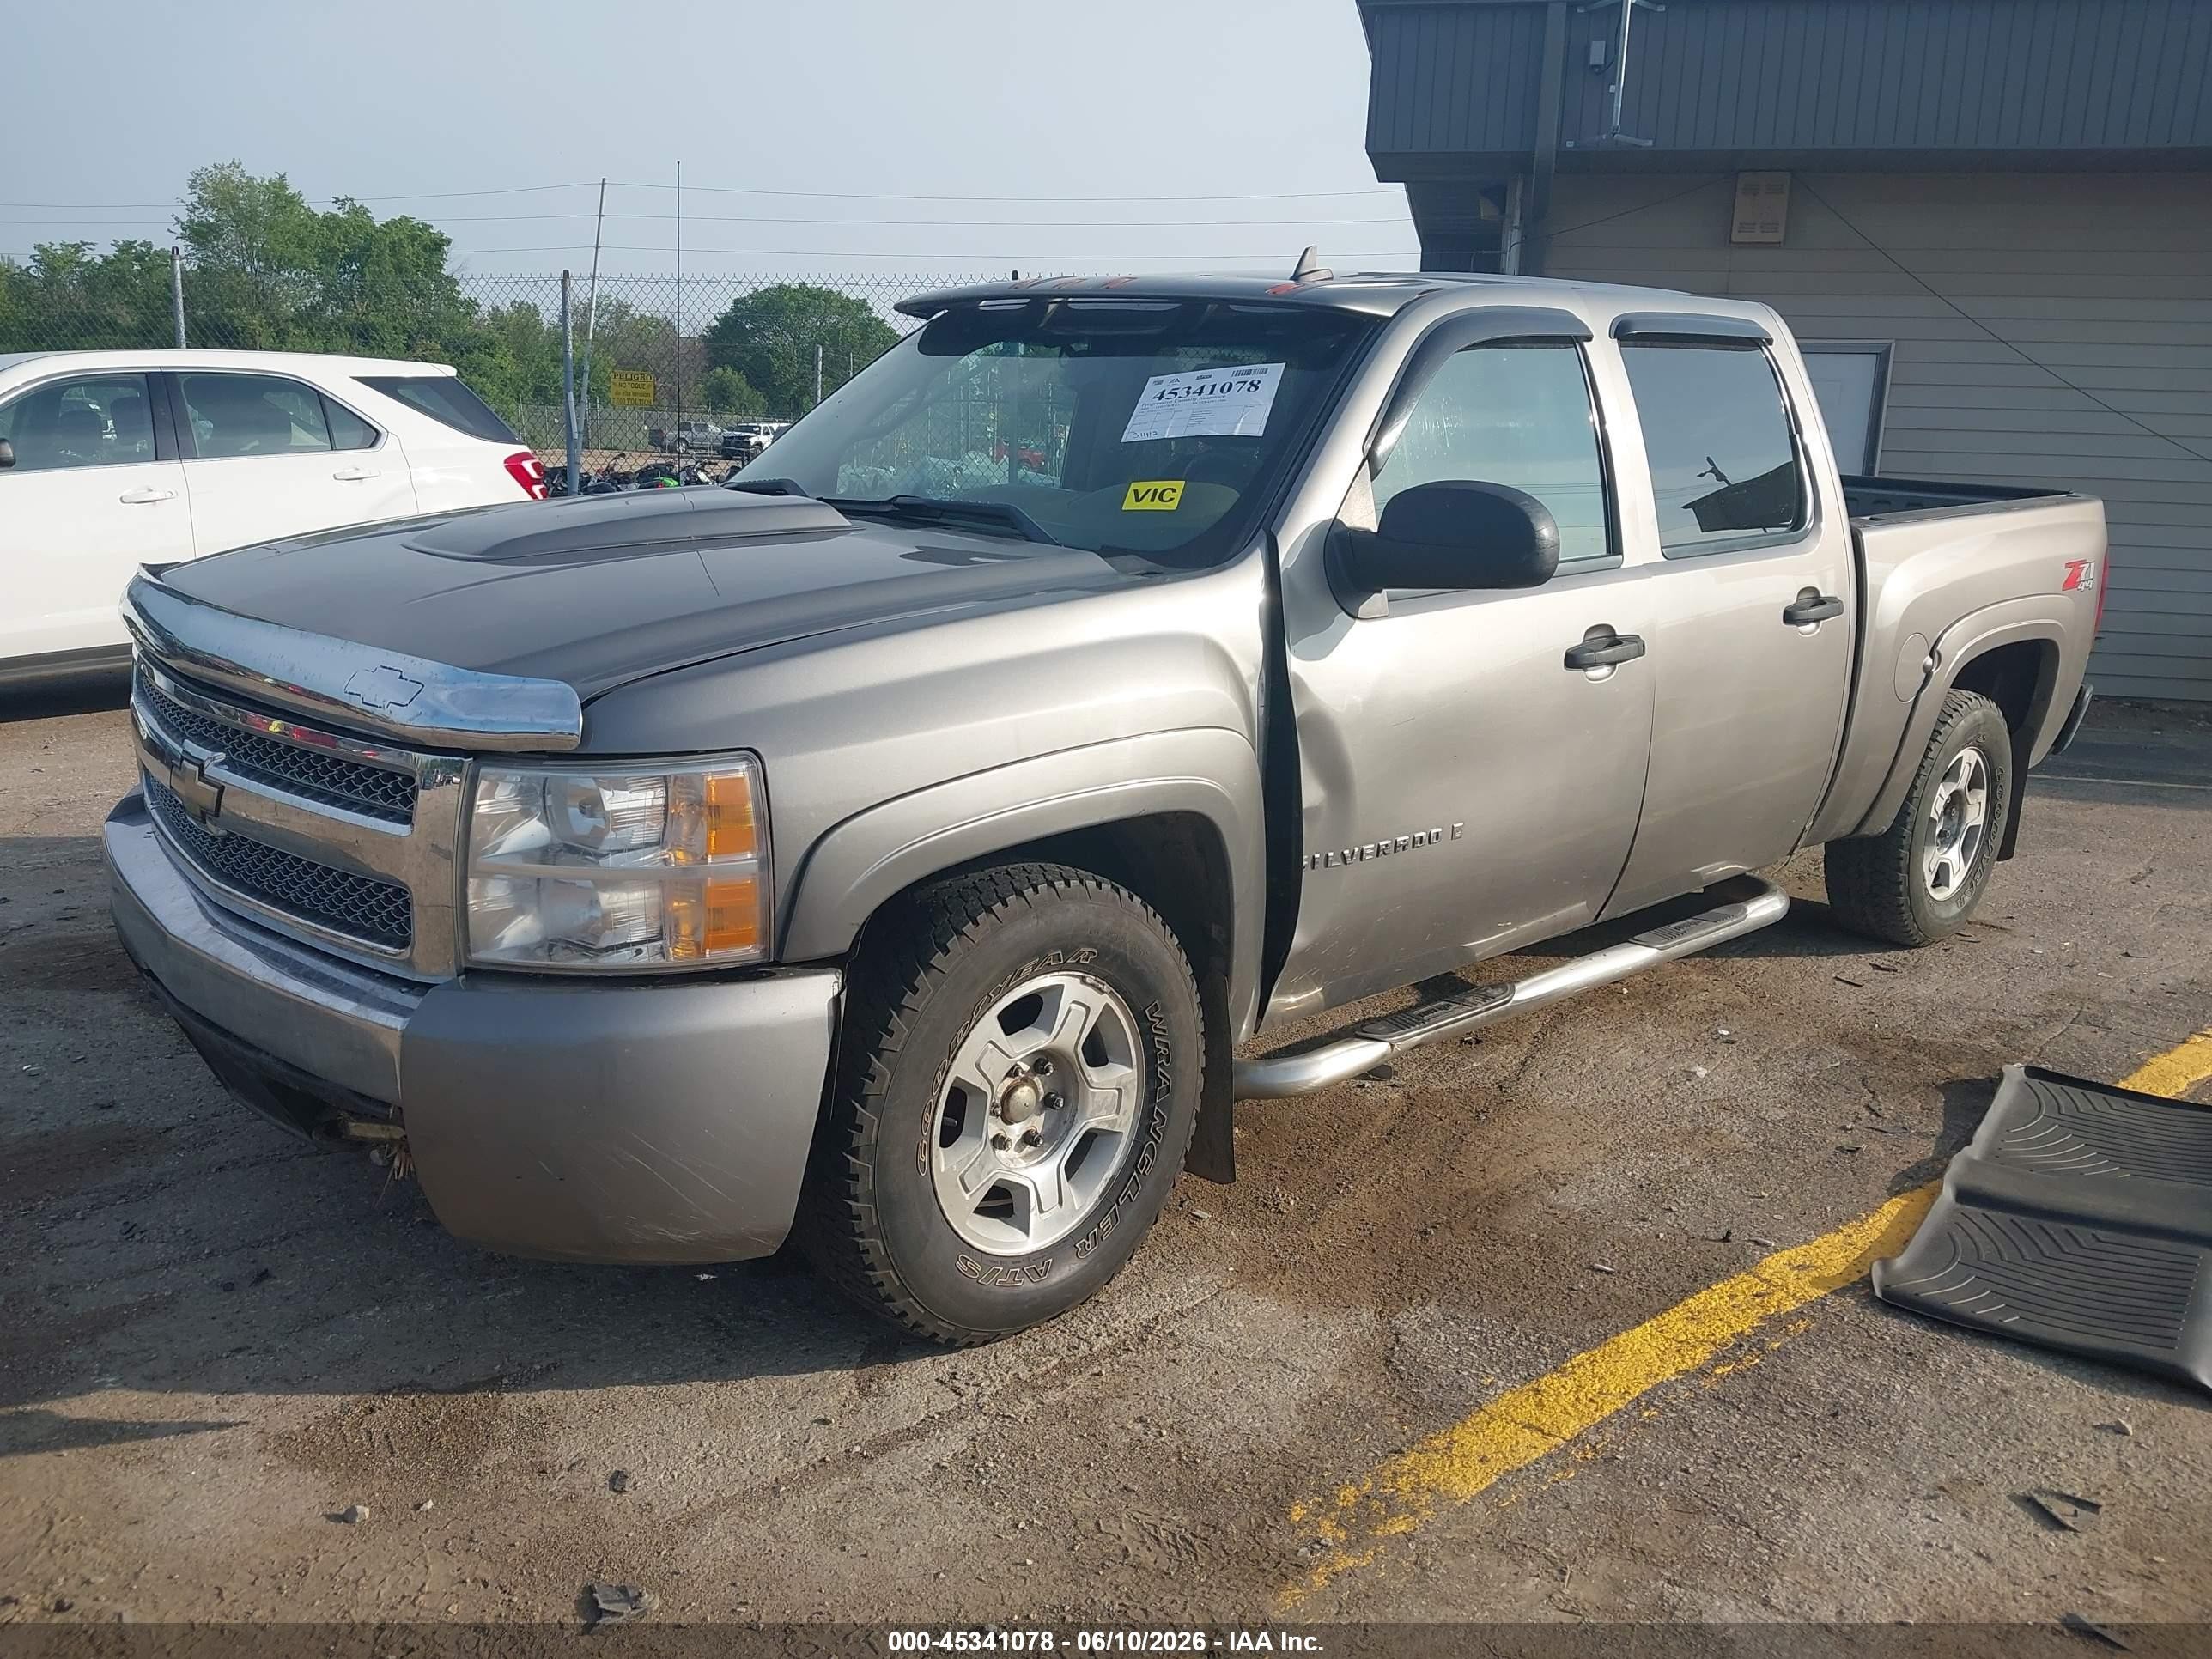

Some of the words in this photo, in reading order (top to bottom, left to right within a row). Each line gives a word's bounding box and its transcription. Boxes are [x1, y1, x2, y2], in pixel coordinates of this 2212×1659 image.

[1152, 379, 1261, 401] 45341078
[1133, 488, 1177, 502] VIC
[2062, 559, 2095, 591] Z71
[916, 948, 1098, 1176] GOODYEAR
[1074, 1000, 1172, 1259] WRANGLER
[955, 1253, 1054, 1287] AT/S
